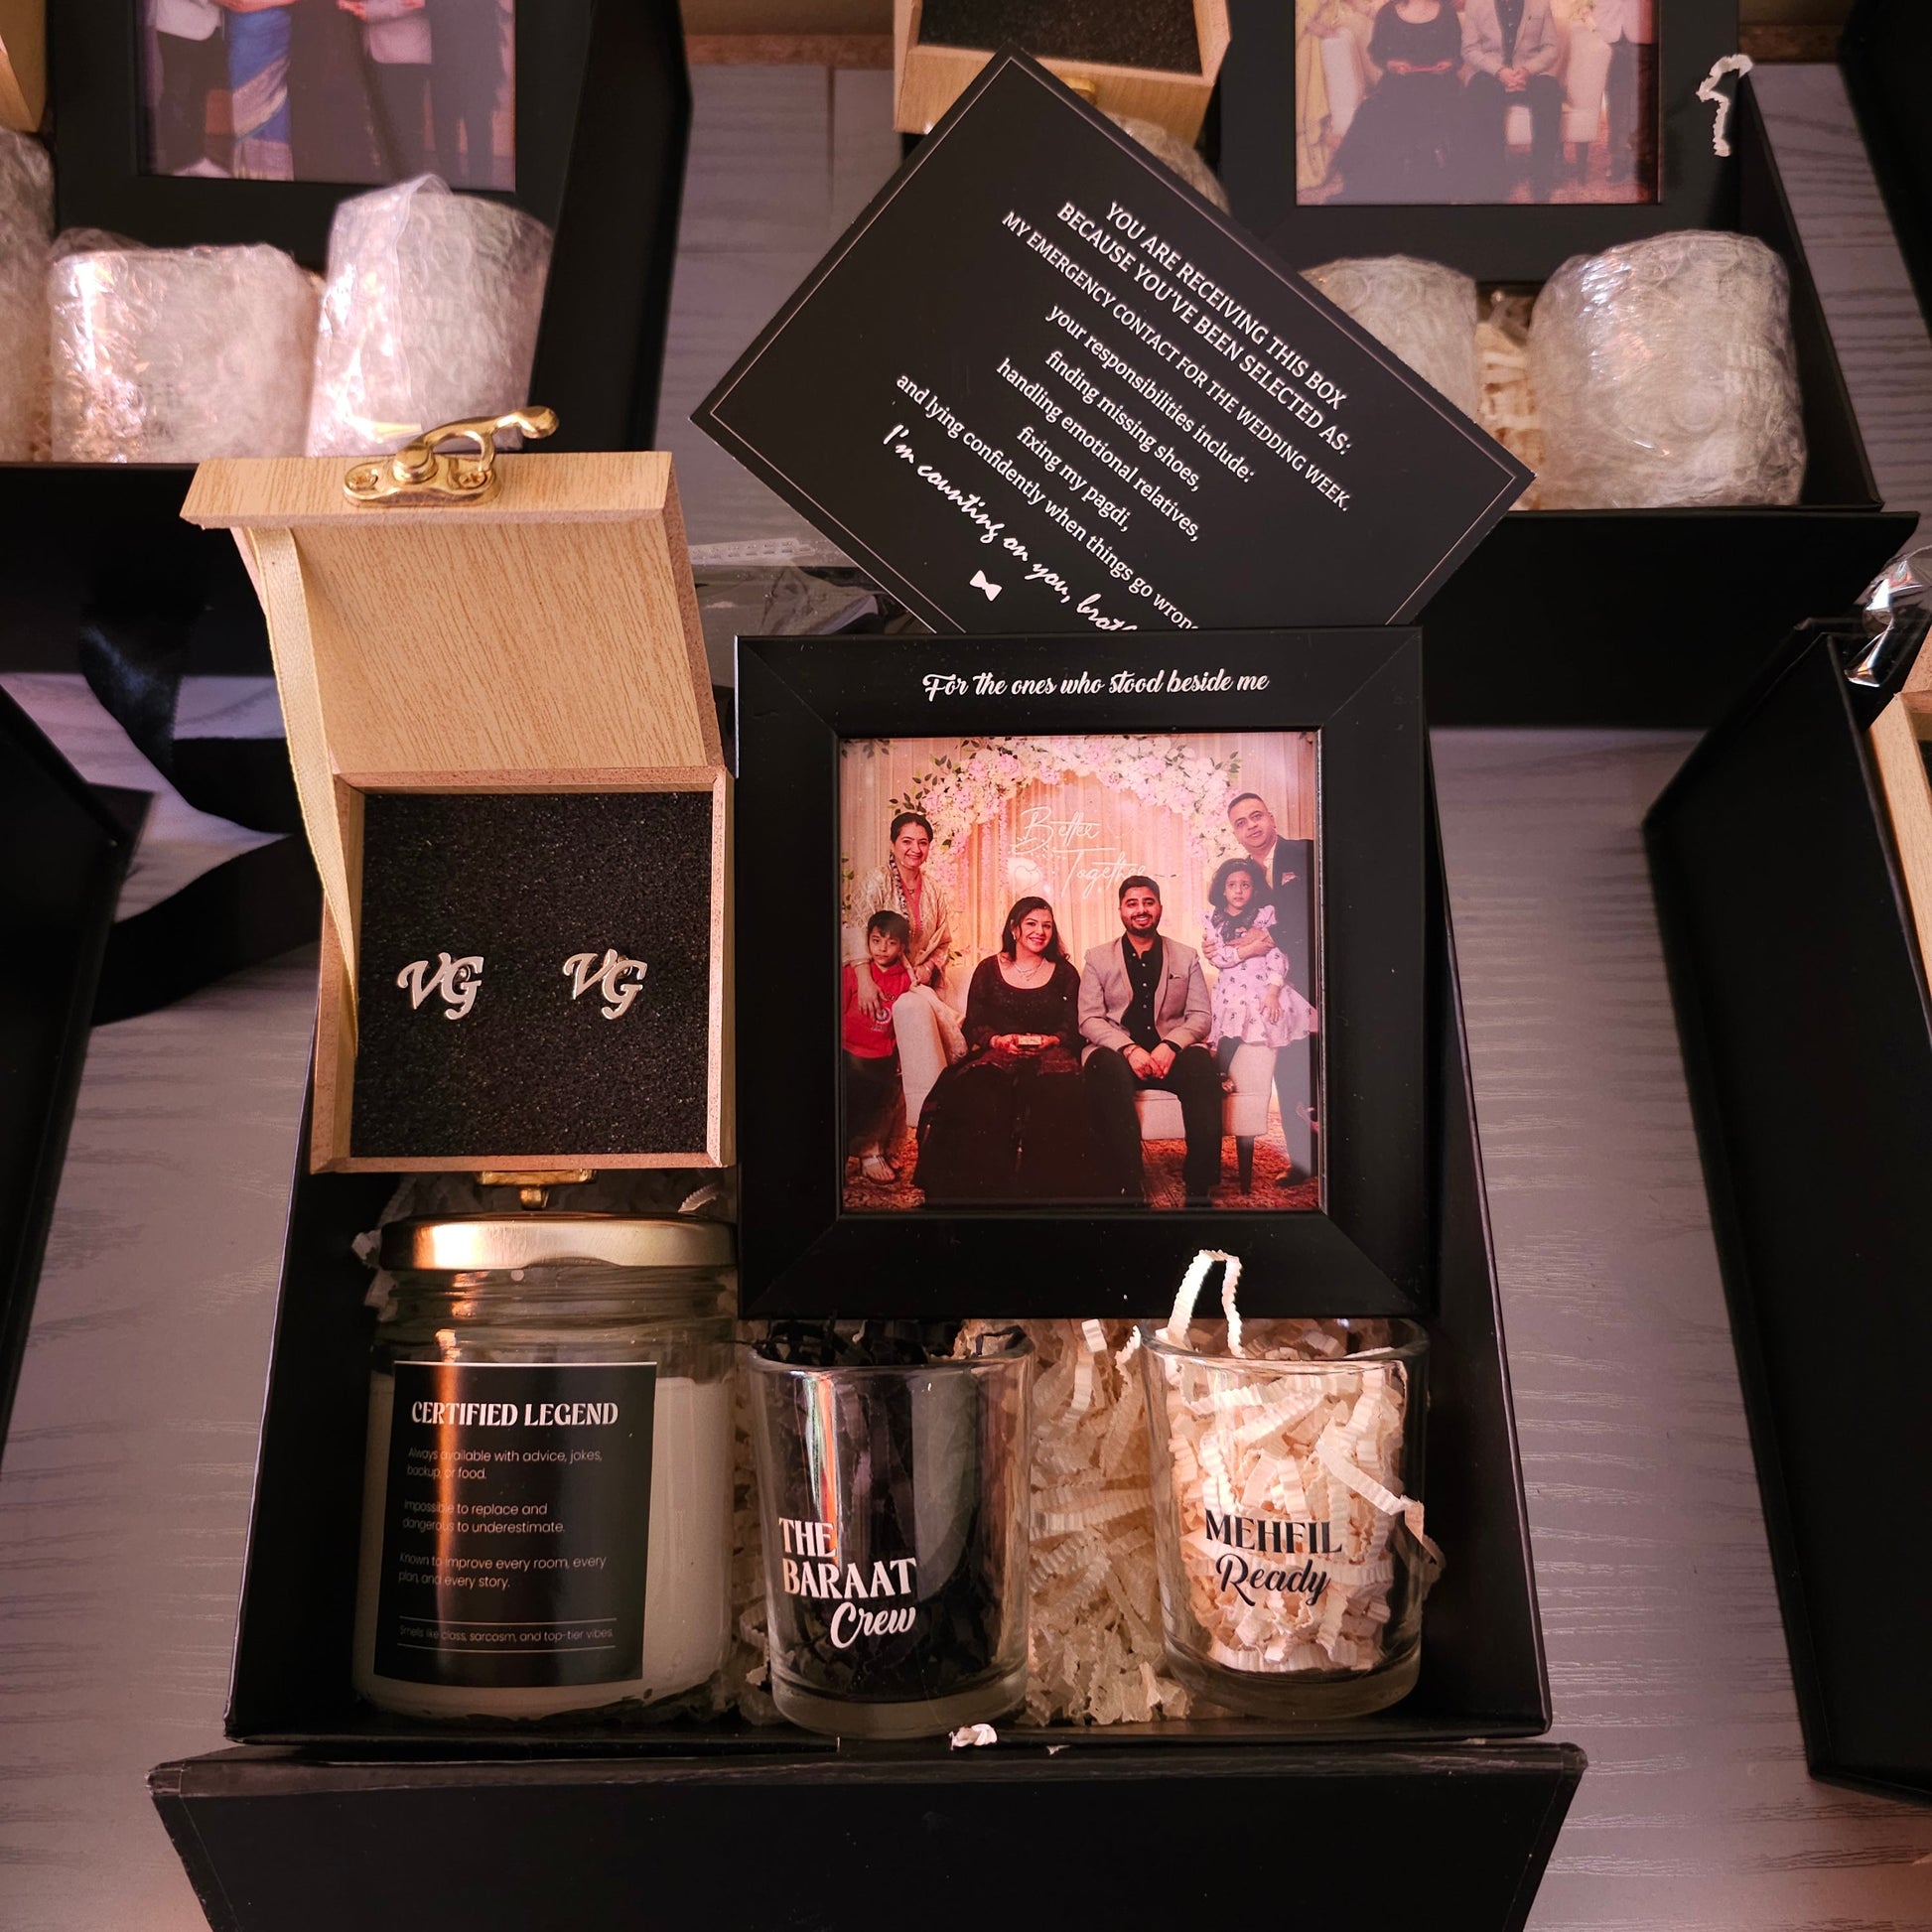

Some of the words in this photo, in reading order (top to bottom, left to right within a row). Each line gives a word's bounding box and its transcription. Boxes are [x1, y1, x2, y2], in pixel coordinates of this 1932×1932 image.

[1056, 202, 1137, 273] BECAUSE
[1134, 262, 1199, 325] YOU'VE
[1192, 315, 1245, 361] BEEN
[1238, 354, 1323, 429] SELECTED
[1318, 425, 1351, 456] AS:
[1106, 202, 1147, 240] YOU
[1140, 235, 1181, 272] ARE
[1175, 262, 1269, 345] RECEIVING
[1265, 336, 1310, 378] THIS
[1304, 370, 1347, 411] BOX
[1002, 210, 1032, 237] MY
[1026, 230, 1117, 308] EMERGENCY
[1113, 303, 1181, 362] CONTACT
[1174, 355, 1209, 389] FOR
[1205, 379, 1240, 414] THE
[1236, 405, 1307, 472] WEDDING
[1305, 464, 1350, 511] WEEK.
[1044, 305, 1087, 341] your
[1083, 335, 1195, 432] responsibilities
[1192, 424, 1255, 483] include:
[1044, 350, 1100, 405] finding
[1096, 396, 1158, 453] missing
[1154, 445, 1199, 492] shoes,
[996, 357, 1063, 424] handling
[1060, 416, 1139, 483] emotional
[1133, 478, 1199, 542] relatives,
[897, 375, 930, 405] and
[924, 395, 965, 439] lying
[962, 432, 1046, 505] confidently
[1044, 499, 1087, 542] when
[1085, 535, 1134, 581] things
[1128, 577, 1154, 598] go
[1153, 593, 1198, 629] wron
[1017, 426, 1062, 473] fixing
[1058, 464, 1088, 491] my
[1080, 485, 1131, 532] pagdi,
[883, 424, 914, 464] I'm
[916, 465, 1006, 544] counting
[1003, 537, 1029, 562] on
[1024, 563, 1071, 604] you,
[1076, 593, 1138, 631] brot
[922, 673, 969, 702] For
[972, 671, 1008, 696] the
[1011, 677, 1056, 695] ones
[1059, 671, 1105, 695] who
[1108, 669, 1165, 694] stood
[1167, 668, 1234, 694] beside
[1236, 674, 1271, 692] me
[1011, 806, 1102, 855] Better
[397, 952, 483, 1020] VG
[563, 948, 647, 1020] VG
[411, 1401, 518, 1427] CERTIFIED
[524, 1402, 620, 1427] LEGEND
[408, 1448, 438, 1462] Always
[440, 1449, 491, 1462] available
[494, 1449, 520, 1462] with
[522, 1449, 567, 1463] advice,
[569, 1449, 603, 1465] jokes,
[444, 1469, 456, 1479] or
[458, 1466, 486, 1479] food.
[457, 1503, 470, 1515] to
[472, 1502, 519, 1518] replace
[521, 1502, 548, 1516] and
[457, 1521, 470, 1533] to
[472, 1520, 565, 1534] underestimate.
[1205, 1510, 1343, 1555] MEHFIL
[778, 1517, 837, 1558] THE
[399, 1552, 430, 1567] Known
[431, 1556, 443, 1567] to
[445, 1556, 493, 1571] improve
[495, 1558, 531, 1572] every
[533, 1557, 570, 1570] room,
[573, 1556, 608, 1571] every
[421, 1573, 442, 1586] and
[444, 1576, 476, 1589] every
[479, 1574, 511, 1591] story.
[781, 1558, 918, 1600] BARAAT
[1216, 1552, 1331, 1607] Ready
[470, 1631, 516, 1643] sarcasm,
[519, 1629, 542, 1642] and
[543, 1629, 584, 1644] top-tier
[586, 1627, 614, 1639] vibes.
[830, 1601, 918, 1649] Crew
